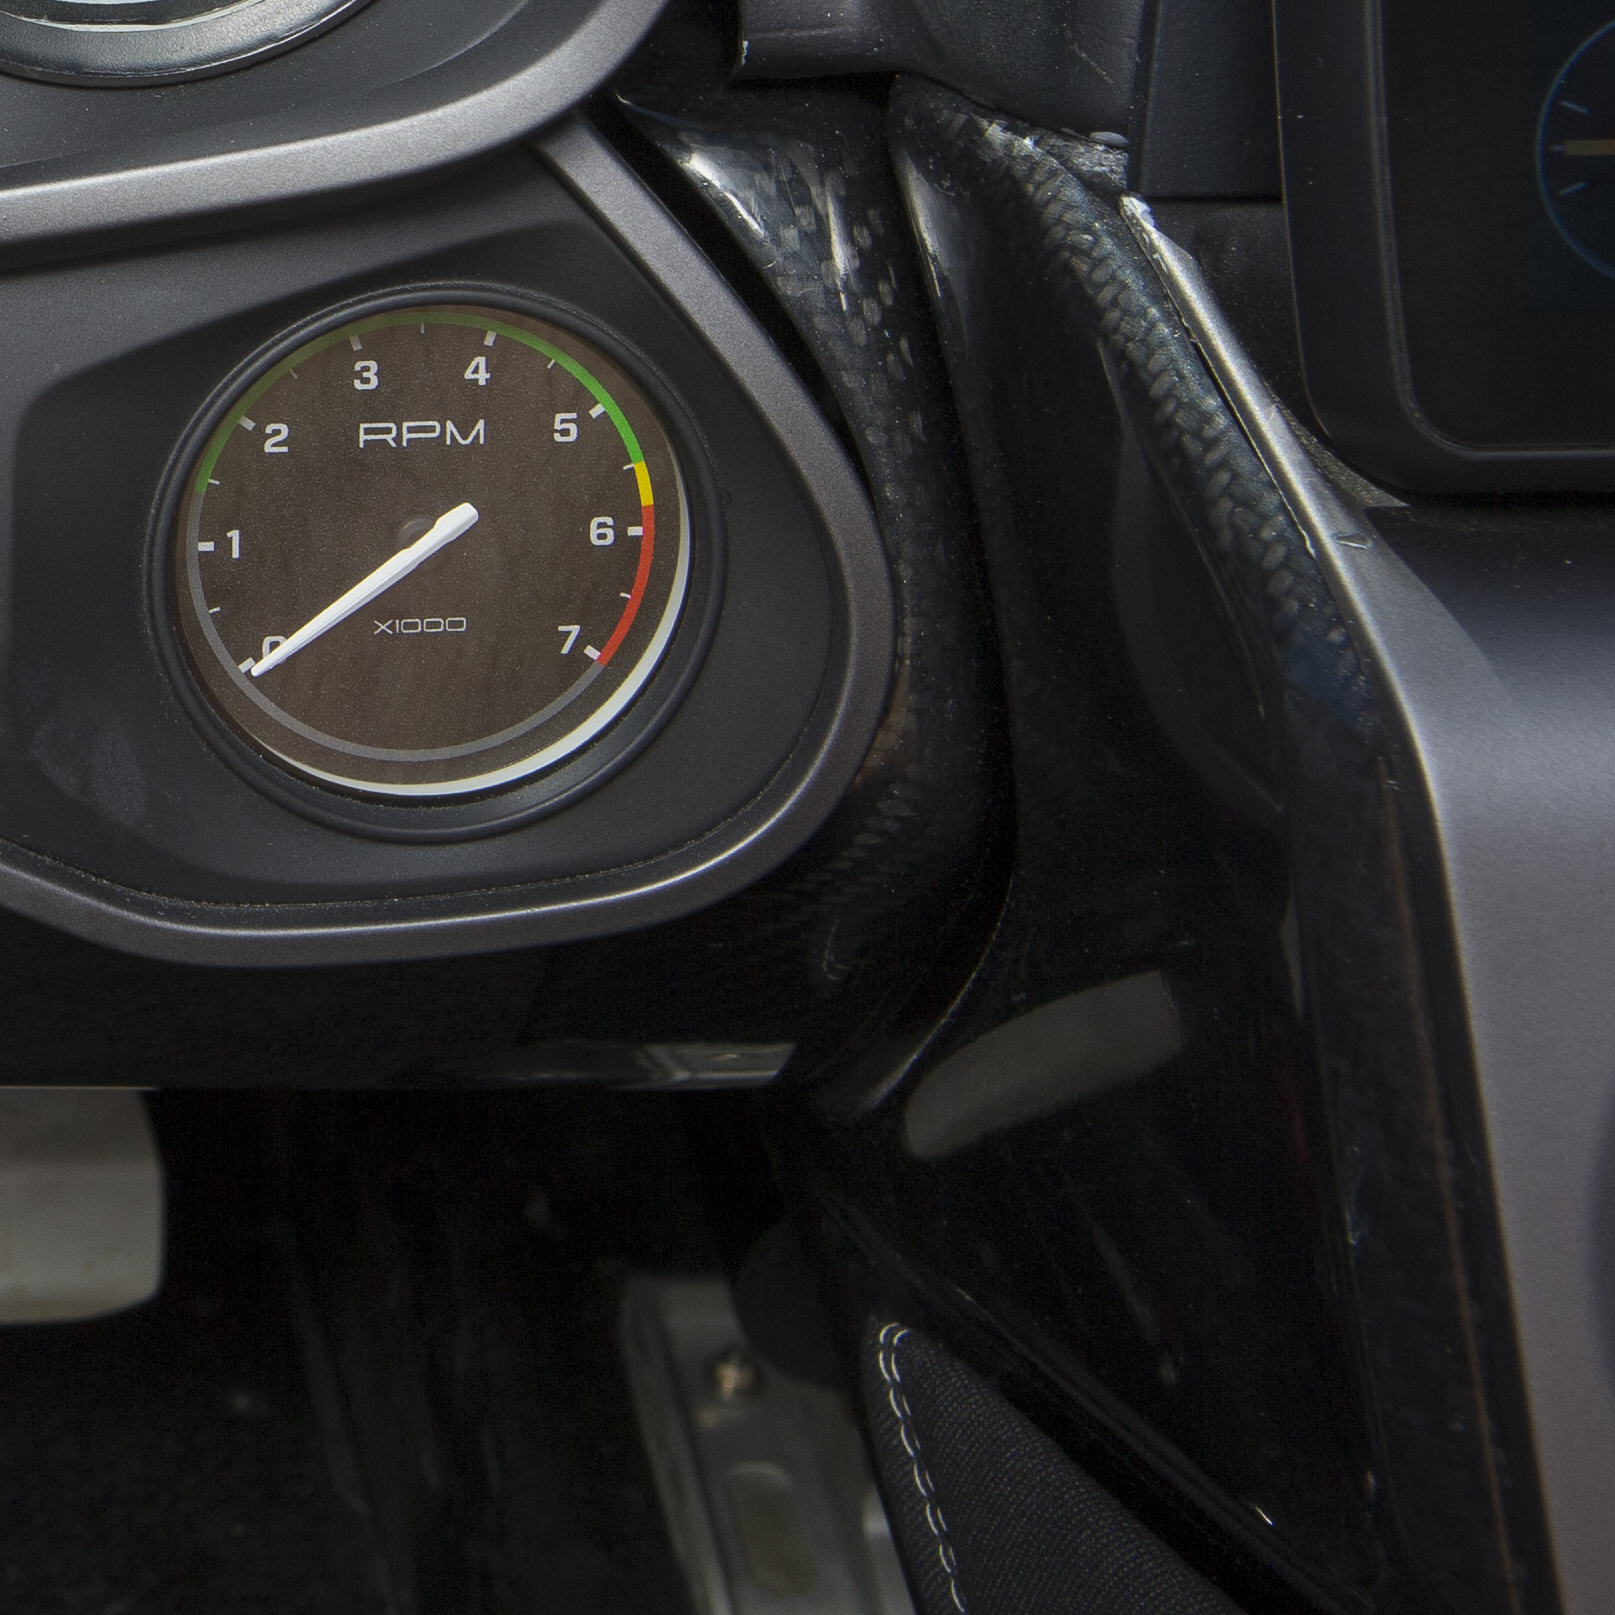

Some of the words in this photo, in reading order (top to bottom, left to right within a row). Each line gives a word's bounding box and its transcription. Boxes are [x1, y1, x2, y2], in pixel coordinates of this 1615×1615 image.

[352, 359, 380, 391] 3
[463, 355, 491, 387] 4
[263, 422, 291, 453] 2
[358, 418, 486, 448] RPM
[552, 412, 579, 443] 5
[225, 529, 241, 560] 1
[589, 515, 616, 546] 6
[373, 616, 467, 635] X1000
[557, 624, 582, 655] 7
